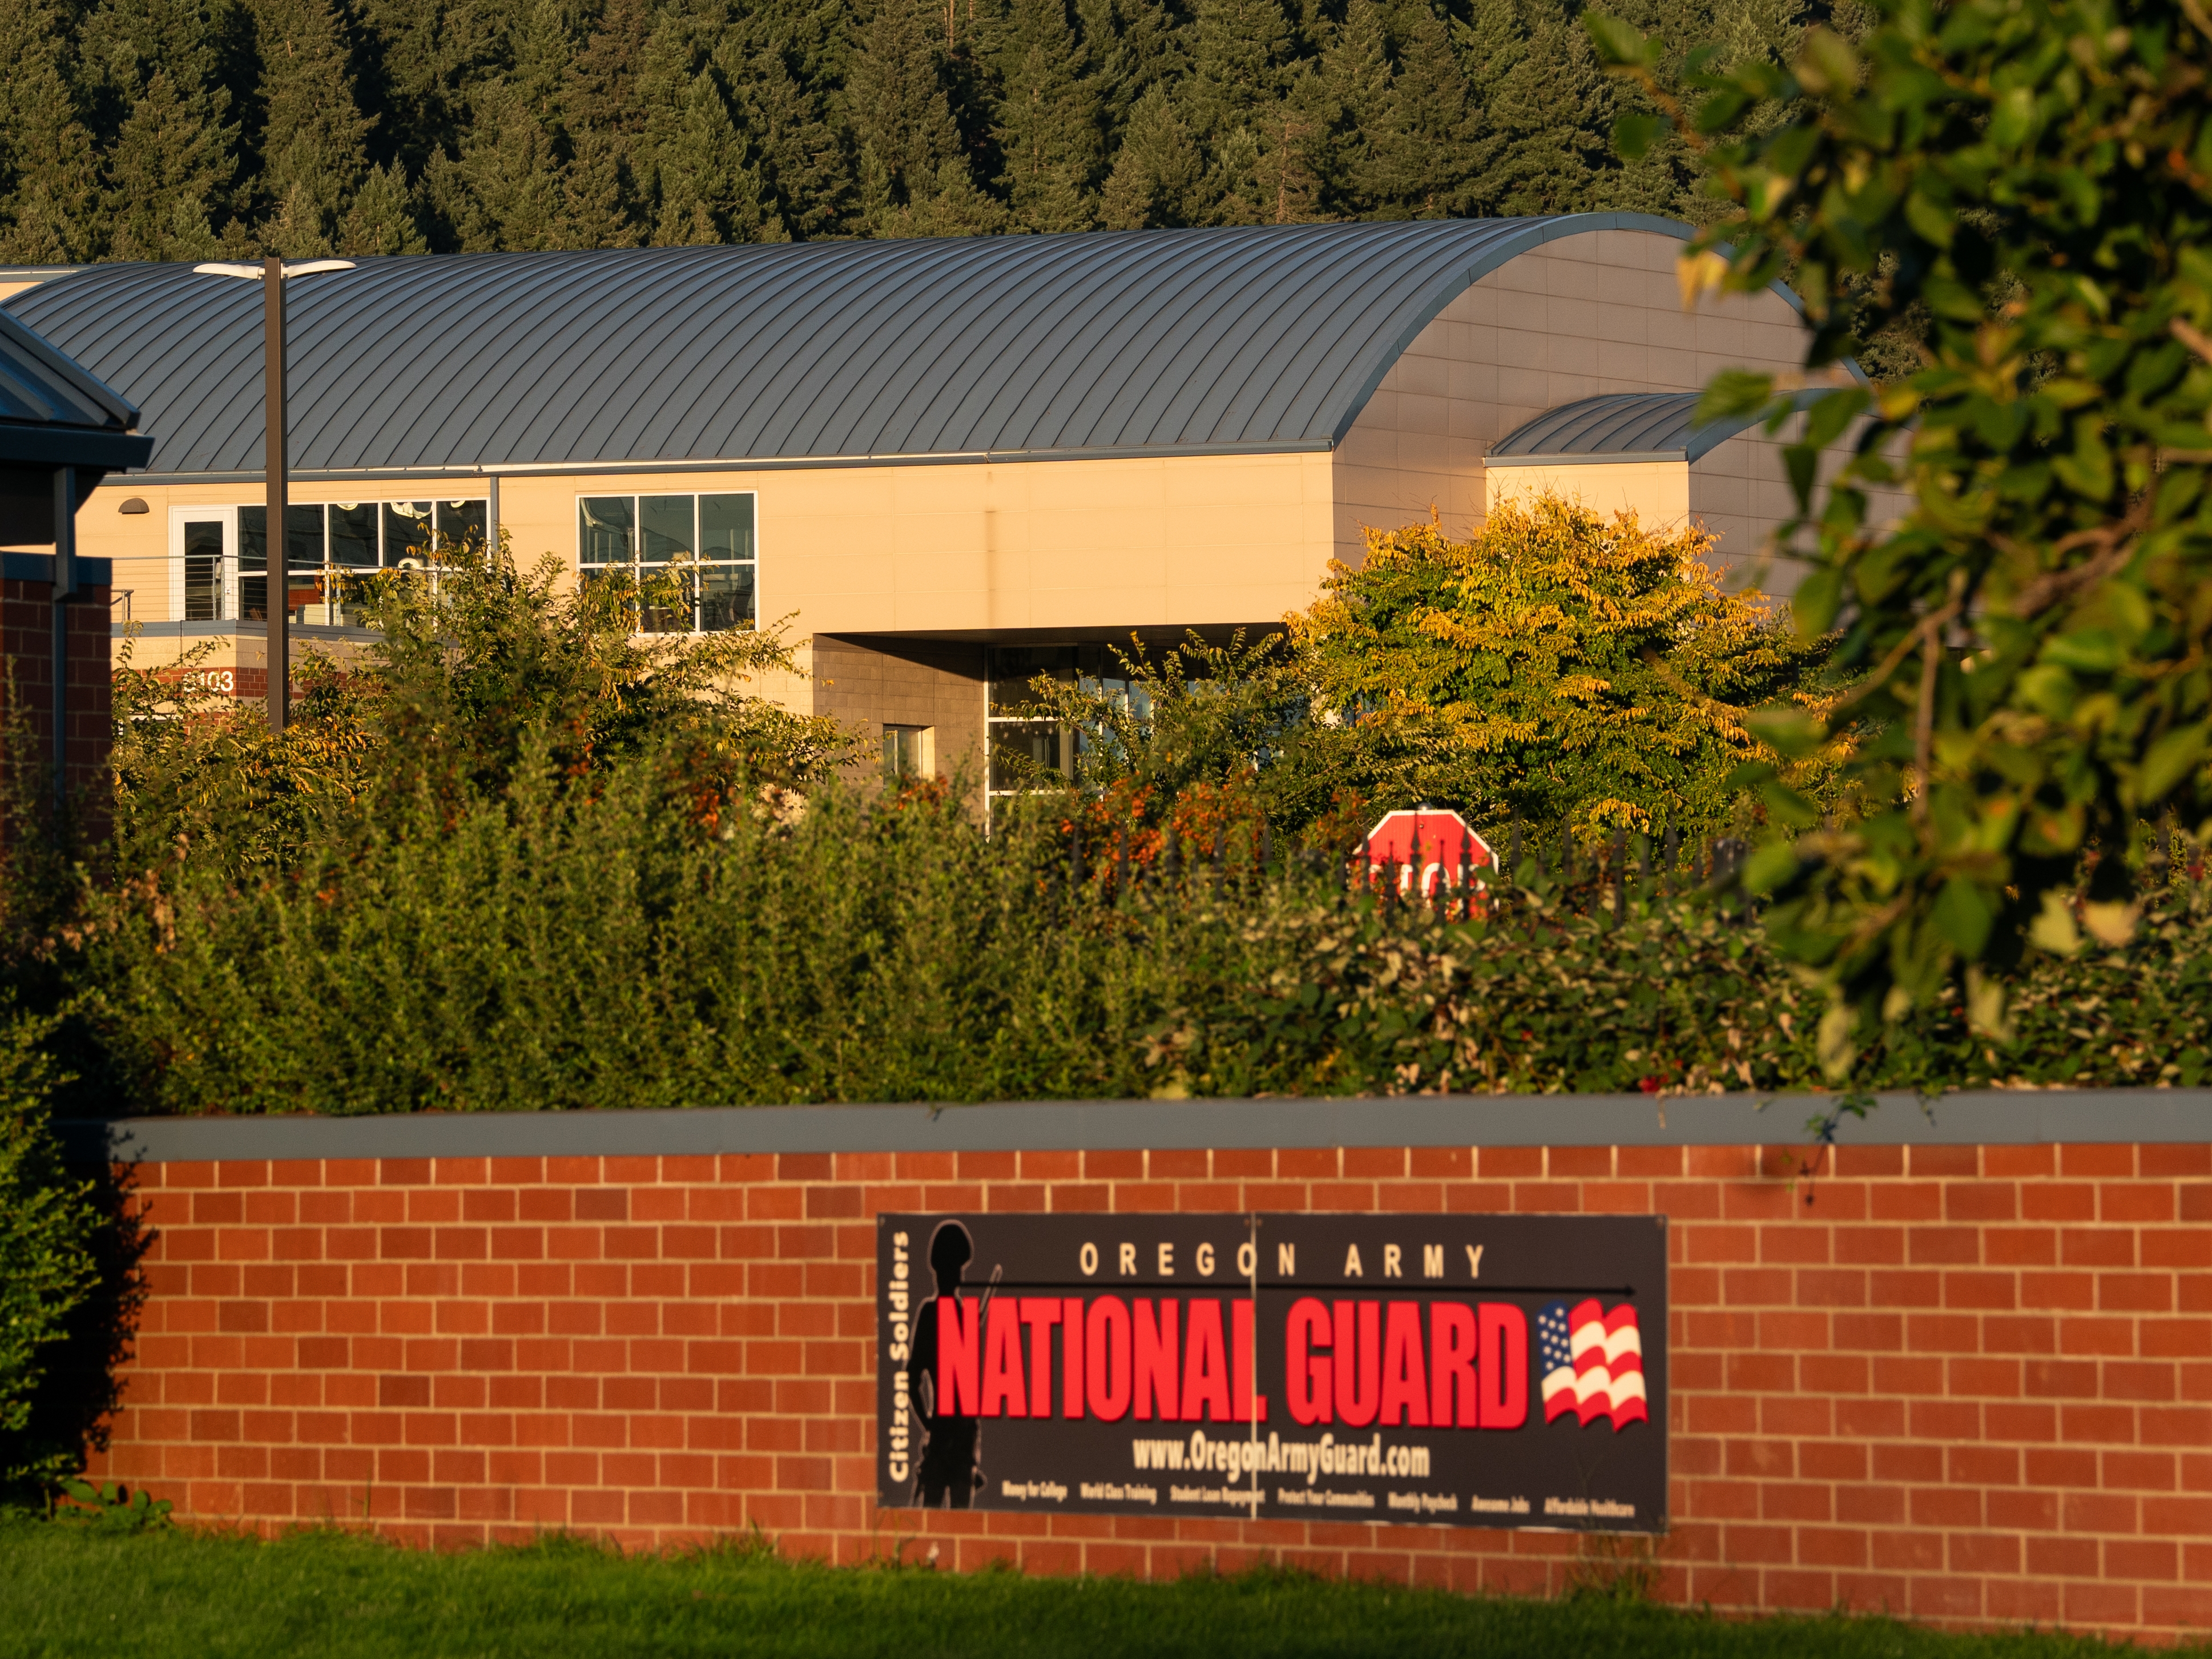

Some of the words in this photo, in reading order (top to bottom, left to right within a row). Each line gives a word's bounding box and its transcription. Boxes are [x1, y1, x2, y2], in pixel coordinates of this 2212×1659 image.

[888, 1231, 909, 1362] Soldiers
[1080, 1242, 1295, 1277] OREGON
[1344, 1244, 1484, 1278] ARMY
[937, 1295, 1268, 1423] NATIONAL
[1286, 1296, 1529, 1430] GUARD
[889, 1371, 909, 1483] Citizen
[1133, 1430, 1430, 1485] www.OregonArmyGuard.com
[1221, 1486, 1266, 1508] Repaymnt
